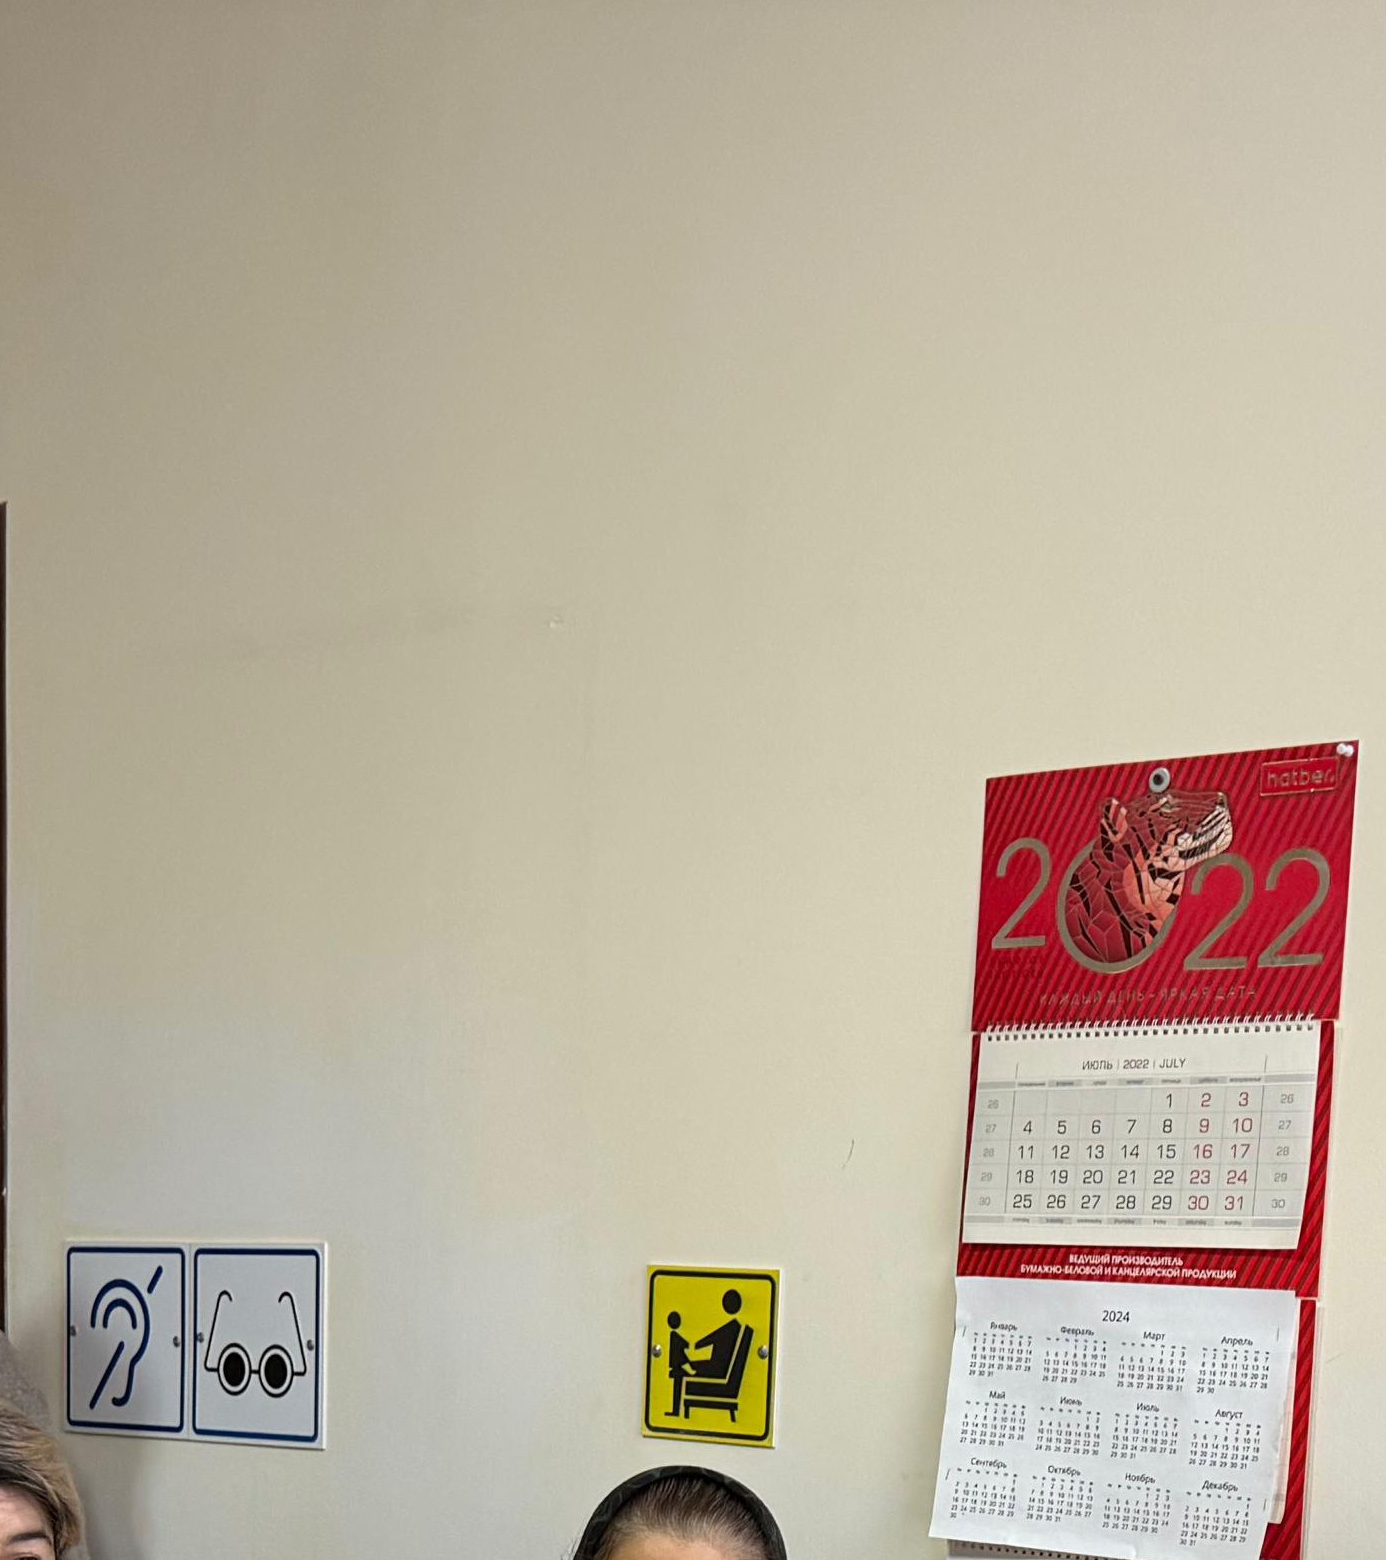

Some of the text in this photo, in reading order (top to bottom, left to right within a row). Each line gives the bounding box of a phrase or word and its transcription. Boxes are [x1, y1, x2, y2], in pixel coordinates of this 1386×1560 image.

[1082, 1058, 1186, 1070] ИЮЛЬ 2022 JULY
[1166, 1094, 1172, 1108] 1
[1201, 1093, 1211, 1107] 2
[1238, 1092, 1249, 1106] 3
[1023, 1121, 1032, 1134] 4
[1057, 1121, 1067, 1134] 5
[1092, 1120, 1101, 1134] 6
[1127, 1120, 1137, 1134] 7
[1163, 1119, 1172, 1133] 8
[1199, 1119, 1210, 1133] 9
[1233, 1118, 1253, 1133] 10
[1018, 1145, 1034, 1159] 11
[1052, 1145, 1070, 1159] 12
[1086, 1145, 1104, 1159] 13
[1121, 1145, 1139, 1159] 14
[1157, 1144, 1176, 1159] 15
[1193, 1144, 1213, 1159] 16
[1231, 1144, 1250, 1159] 17
[1016, 1170, 1034, 1184] 18
[1050, 1170, 1068, 1184] 19
[1083, 1170, 1103, 1184] 20
[1118, 1170, 1136, 1184] 21
[1153, 1170, 1174, 1184] 22
[1190, 1170, 1210, 1184] 23
[1226, 1170, 1248, 1184] 24
[1013, 1194, 1032, 1208] 25
[1046, 1195, 1066, 1209] 26
[1081, 1195, 1101, 1209] 27
[1116, 1195, 1136, 1209] 28
[1151, 1195, 1172, 1210] 29
[1188, 1196, 1209, 1210] 30
[1224, 1196, 1243, 1210] 31
[1069, 1254, 1183, 1266] ВЕДУЩИЙ ПРОИЗВОДИТЕЛЬ
[1112, 1268, 1180, 1278] КАНЦЕЛЯРСКОЙ
[1182, 1270, 1237, 1280] ПРОДУКЦИИ
[1102, 1310, 1130, 1323] 2024
[990, 1322, 1253, 1346] Январь Февраль Март Апрель
[989, 1391, 1005, 1399] Май
[1136, 1403, 1159, 1412] Июль
[1215, 1409, 1243, 1419] Август
[971, 1457, 1238, 1493] Сентябрь Октябрь Ноябрь Декабрь
